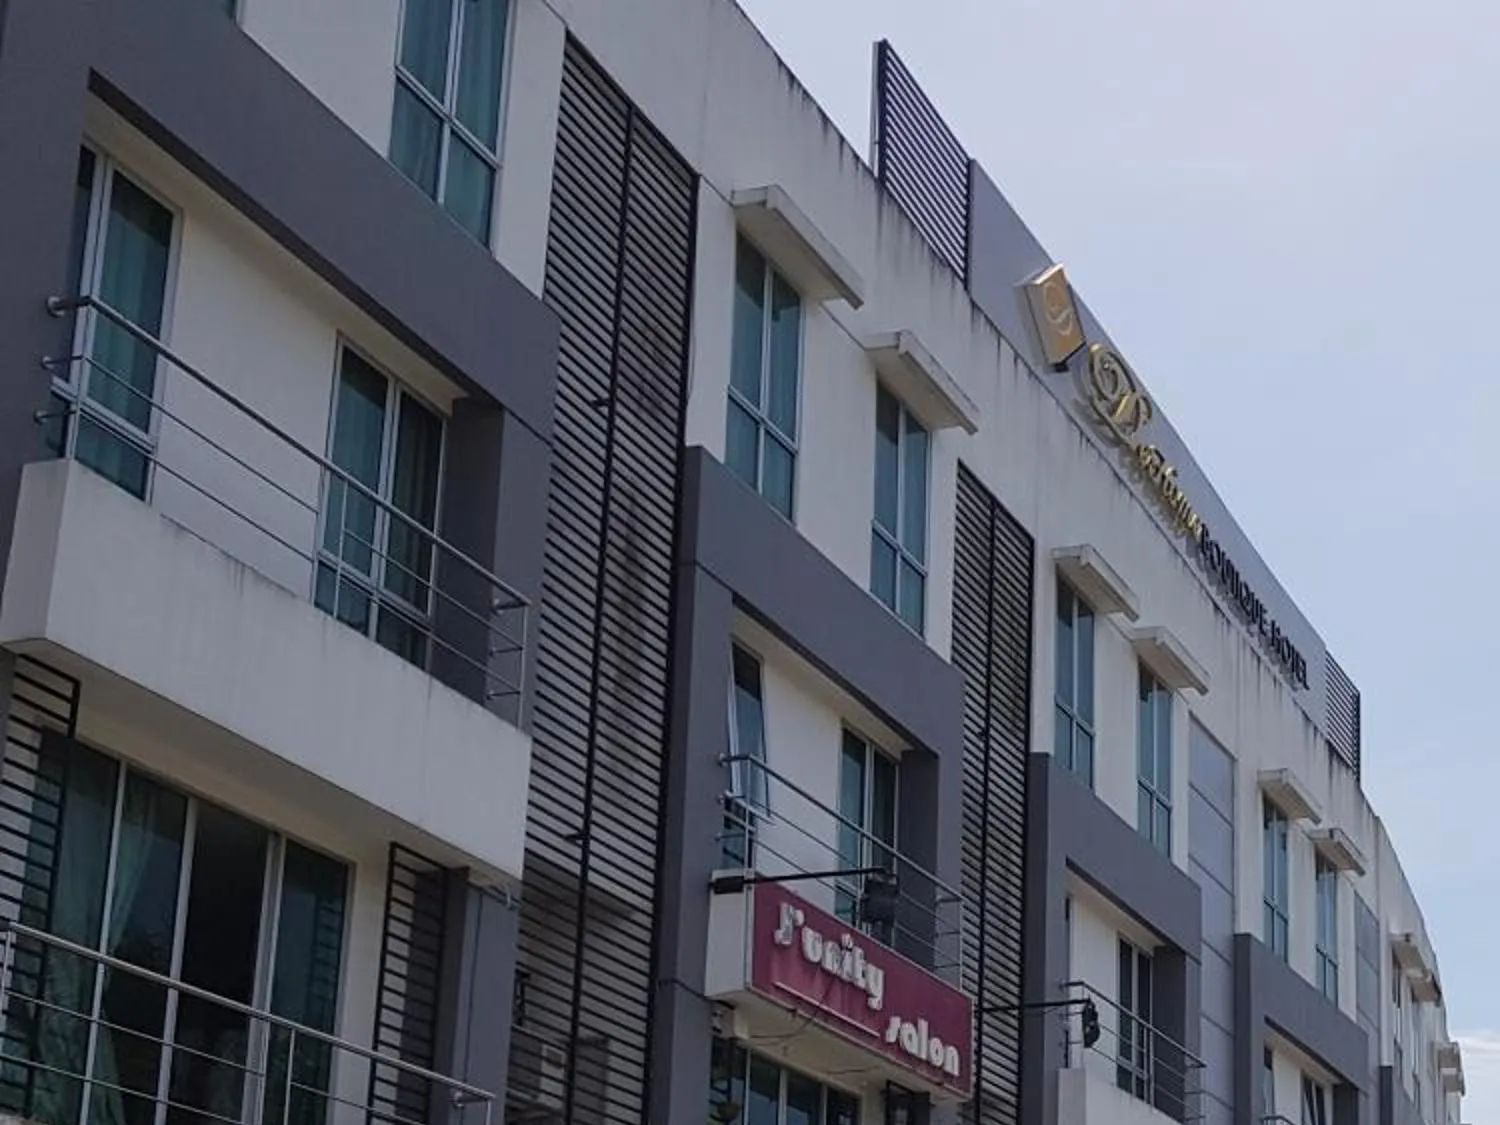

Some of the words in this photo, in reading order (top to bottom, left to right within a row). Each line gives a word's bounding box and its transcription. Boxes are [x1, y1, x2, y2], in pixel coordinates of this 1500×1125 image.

[1200, 522, 1268, 638] BOUTIQUE
[1269, 618, 1311, 691] HOTEL
[885, 1016, 961, 1077] salon
